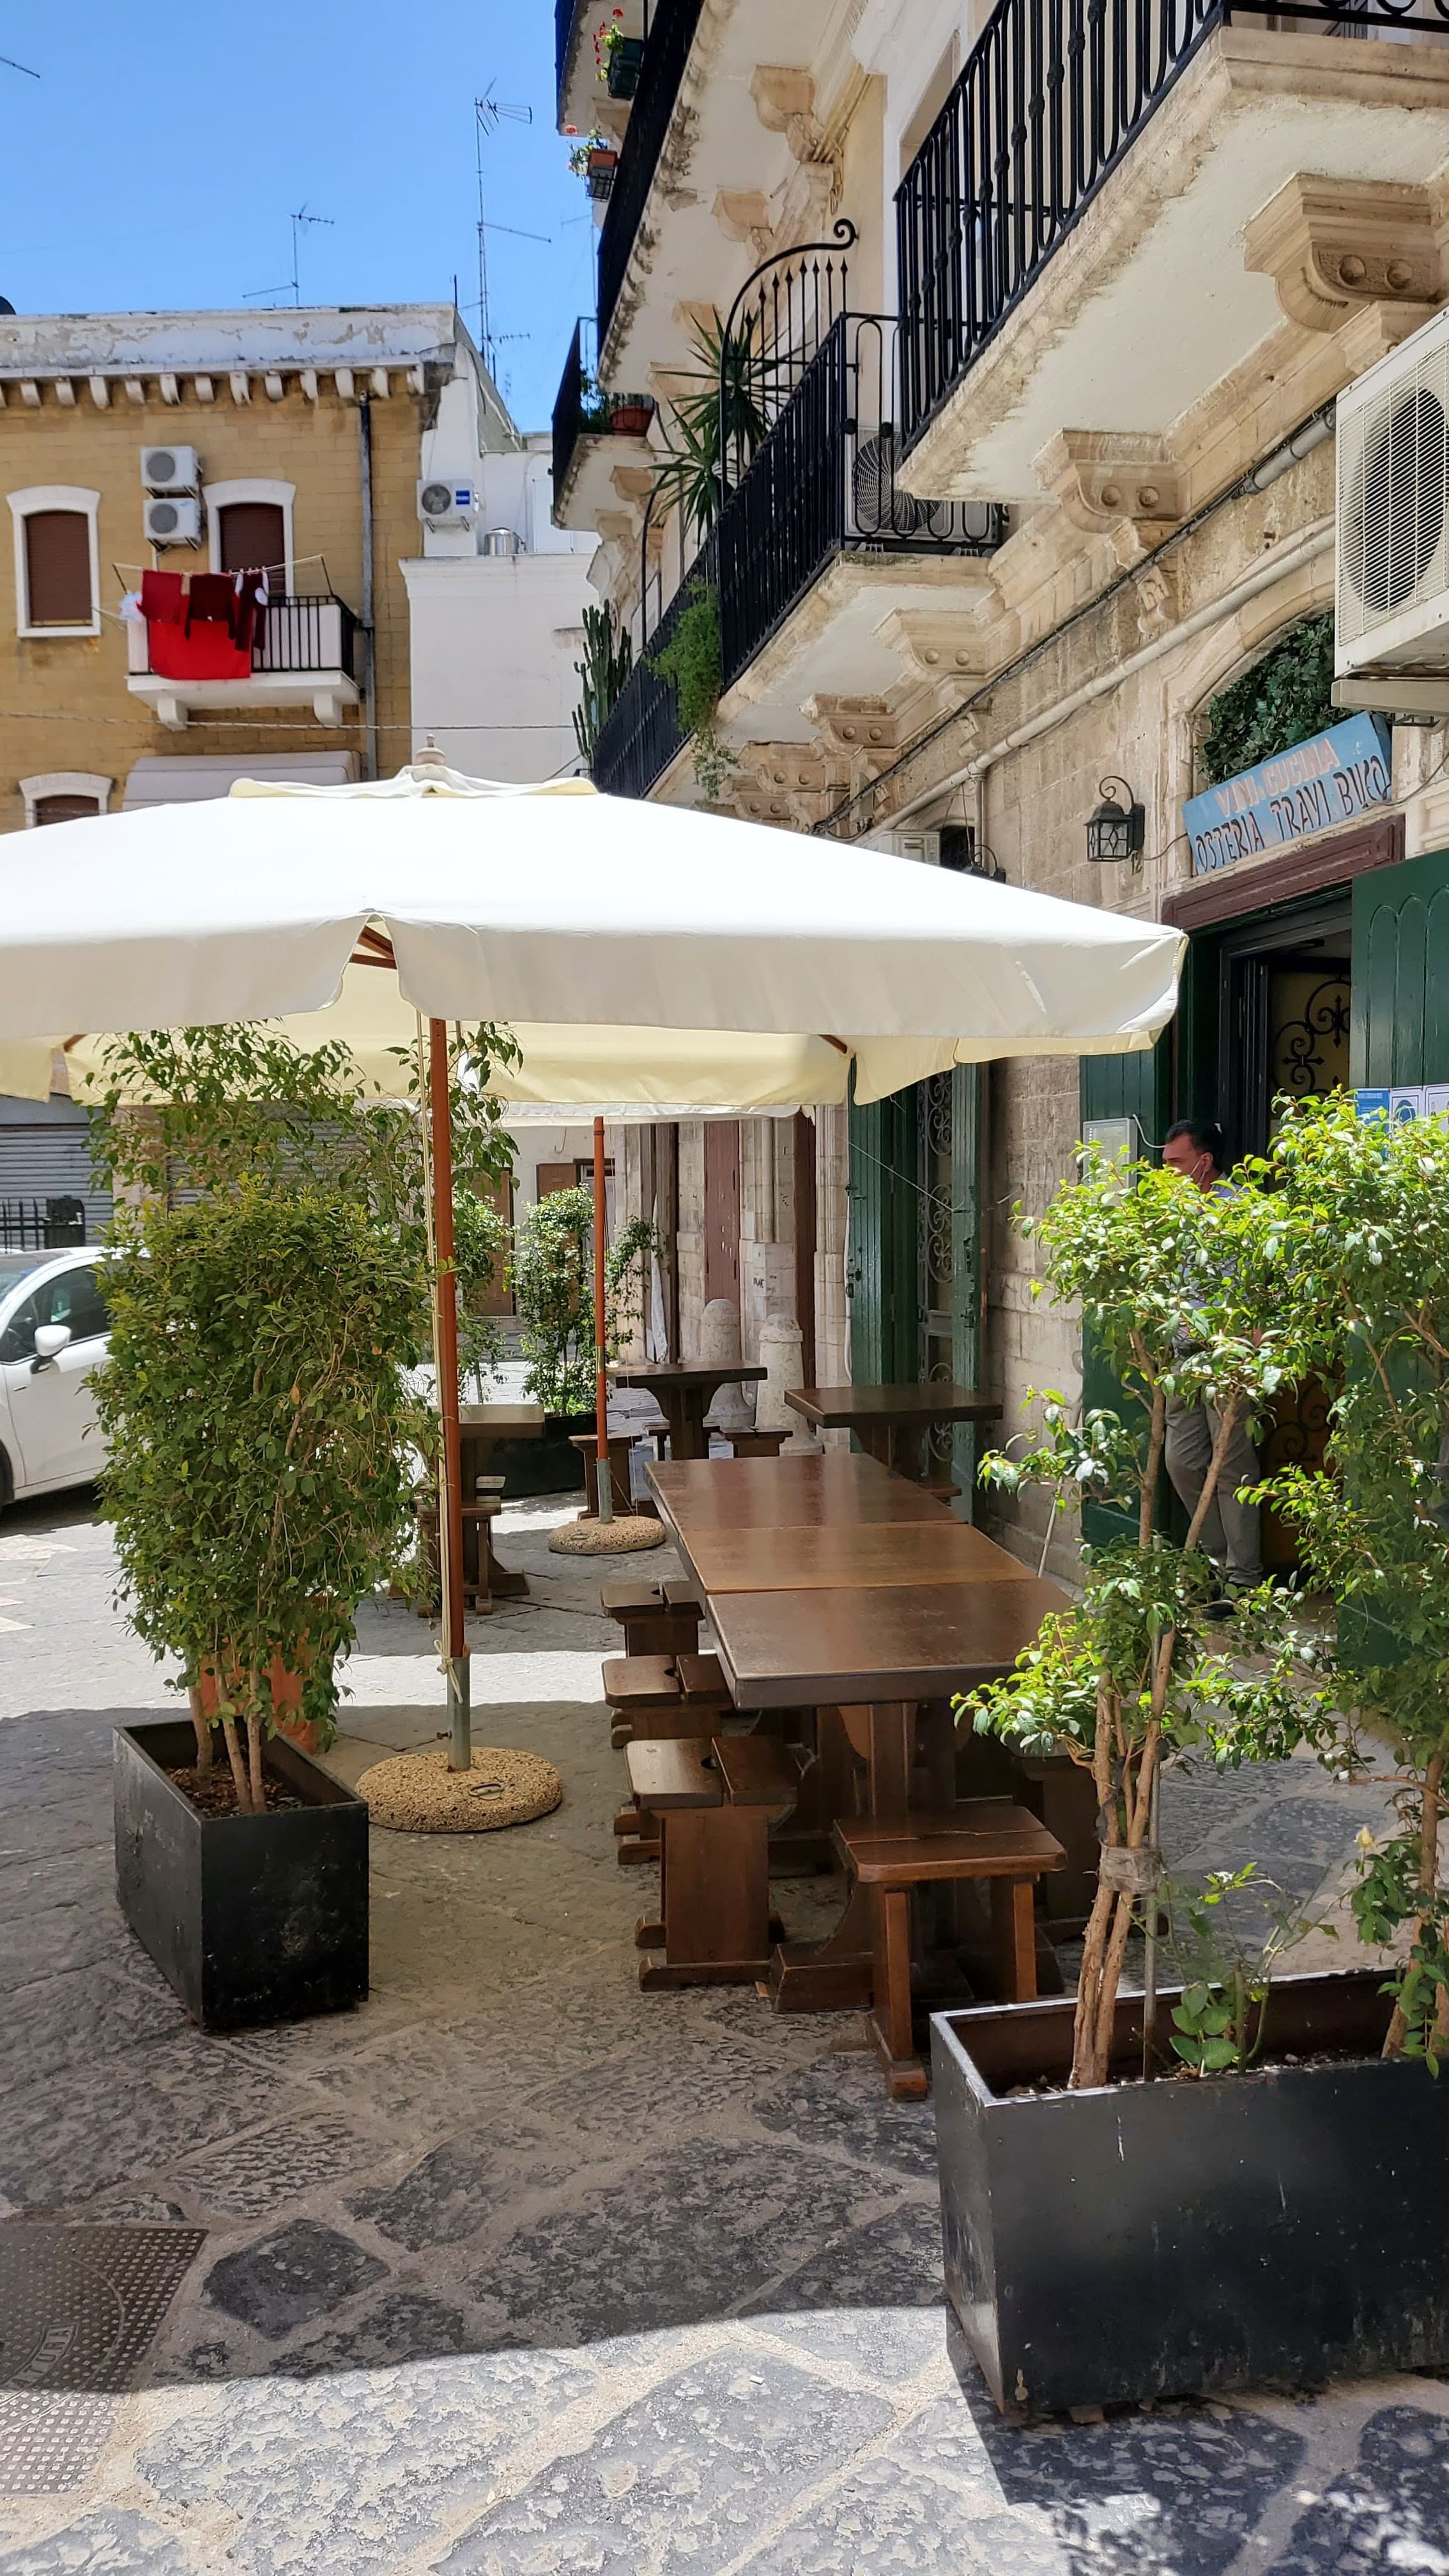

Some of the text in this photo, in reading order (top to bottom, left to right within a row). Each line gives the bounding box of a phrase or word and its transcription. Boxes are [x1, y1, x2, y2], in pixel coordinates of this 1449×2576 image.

[1261, 738, 1340, 797] CUCINA
[1196, 755, 1387, 872] OSTERIA TRAVI BUCO
